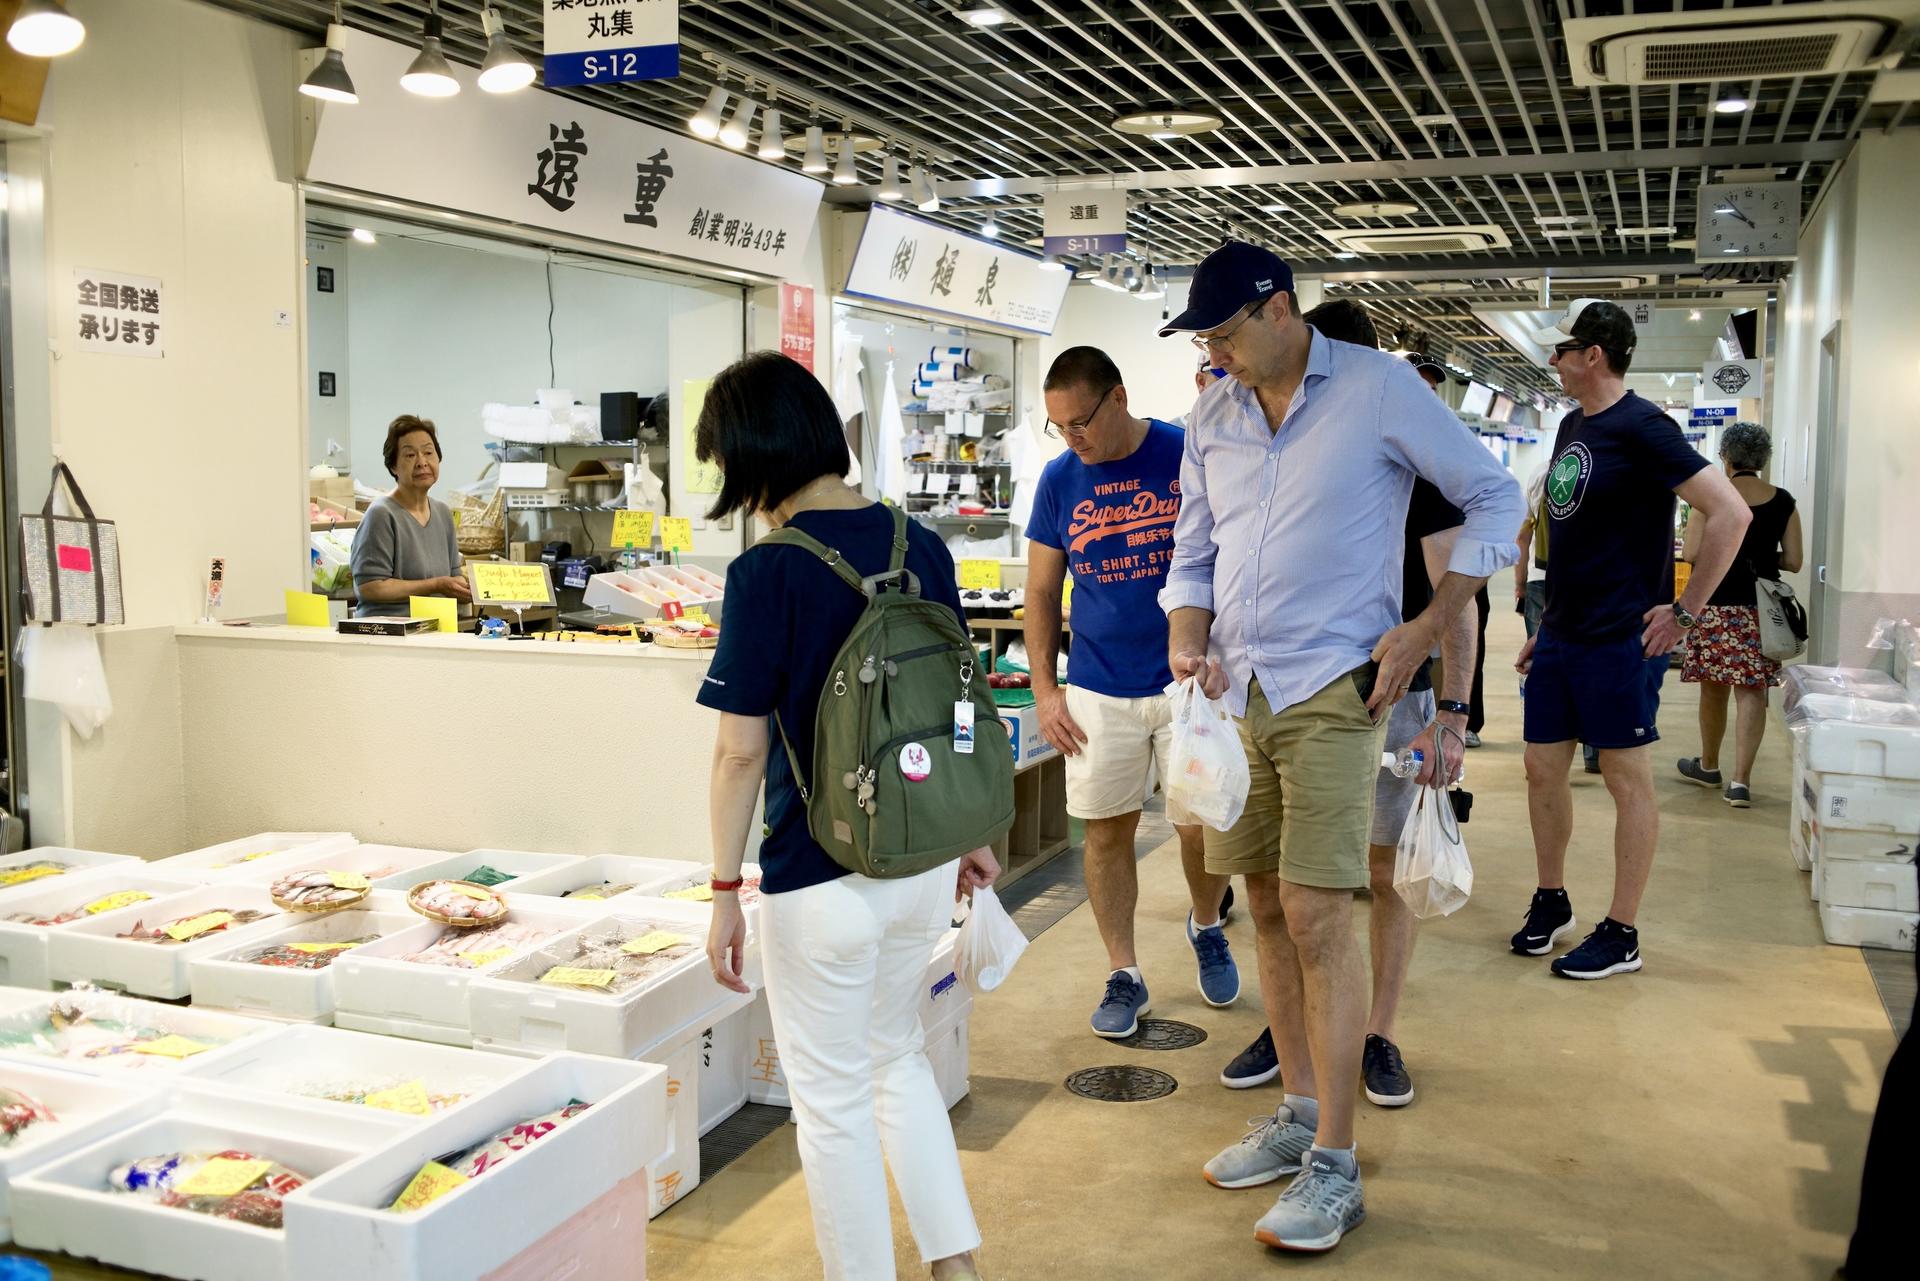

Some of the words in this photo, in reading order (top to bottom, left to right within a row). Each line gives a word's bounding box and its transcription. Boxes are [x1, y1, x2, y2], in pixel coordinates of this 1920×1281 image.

[587, 9, 633, 39] 丸集
[583, 53, 637, 79] S-12
[688, 207, 788, 257] 創業明治43年
[1067, 238, 1099, 251] S-11
[78, 279, 159, 314] 全国発送
[79, 313, 160, 346] 承ります
[1706, 408, 1725, 416] N-09
[1094, 479, 1141, 496] VINTAGE
[1149, 550, 1174, 564] STO
[483, 591, 491, 599] 1
